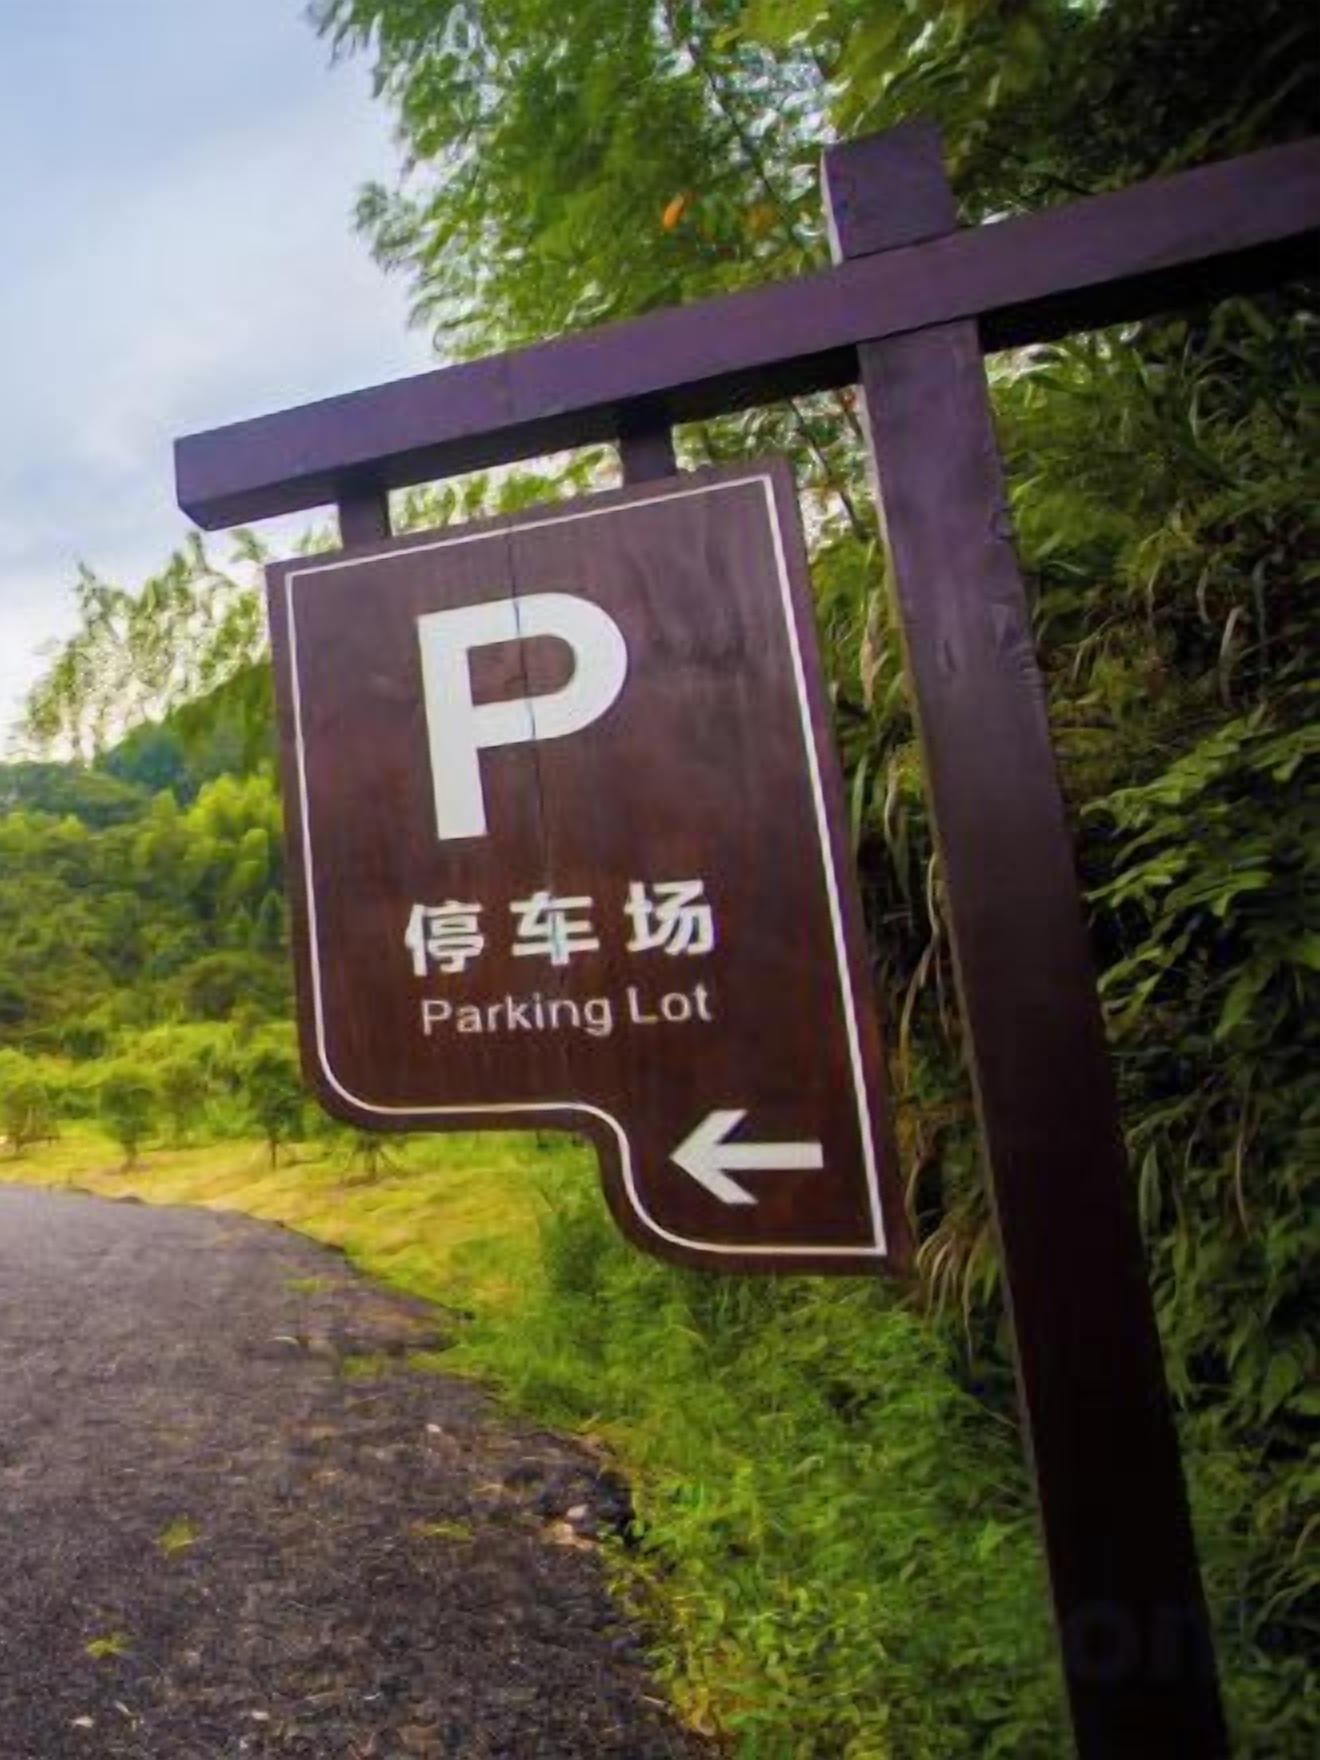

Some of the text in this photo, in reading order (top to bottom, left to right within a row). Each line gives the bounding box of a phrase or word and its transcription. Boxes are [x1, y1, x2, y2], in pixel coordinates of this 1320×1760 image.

[416, 592, 628, 840] P
[404, 879, 716, 976] 停车场
[421, 984, 713, 1036] Parking Lot
